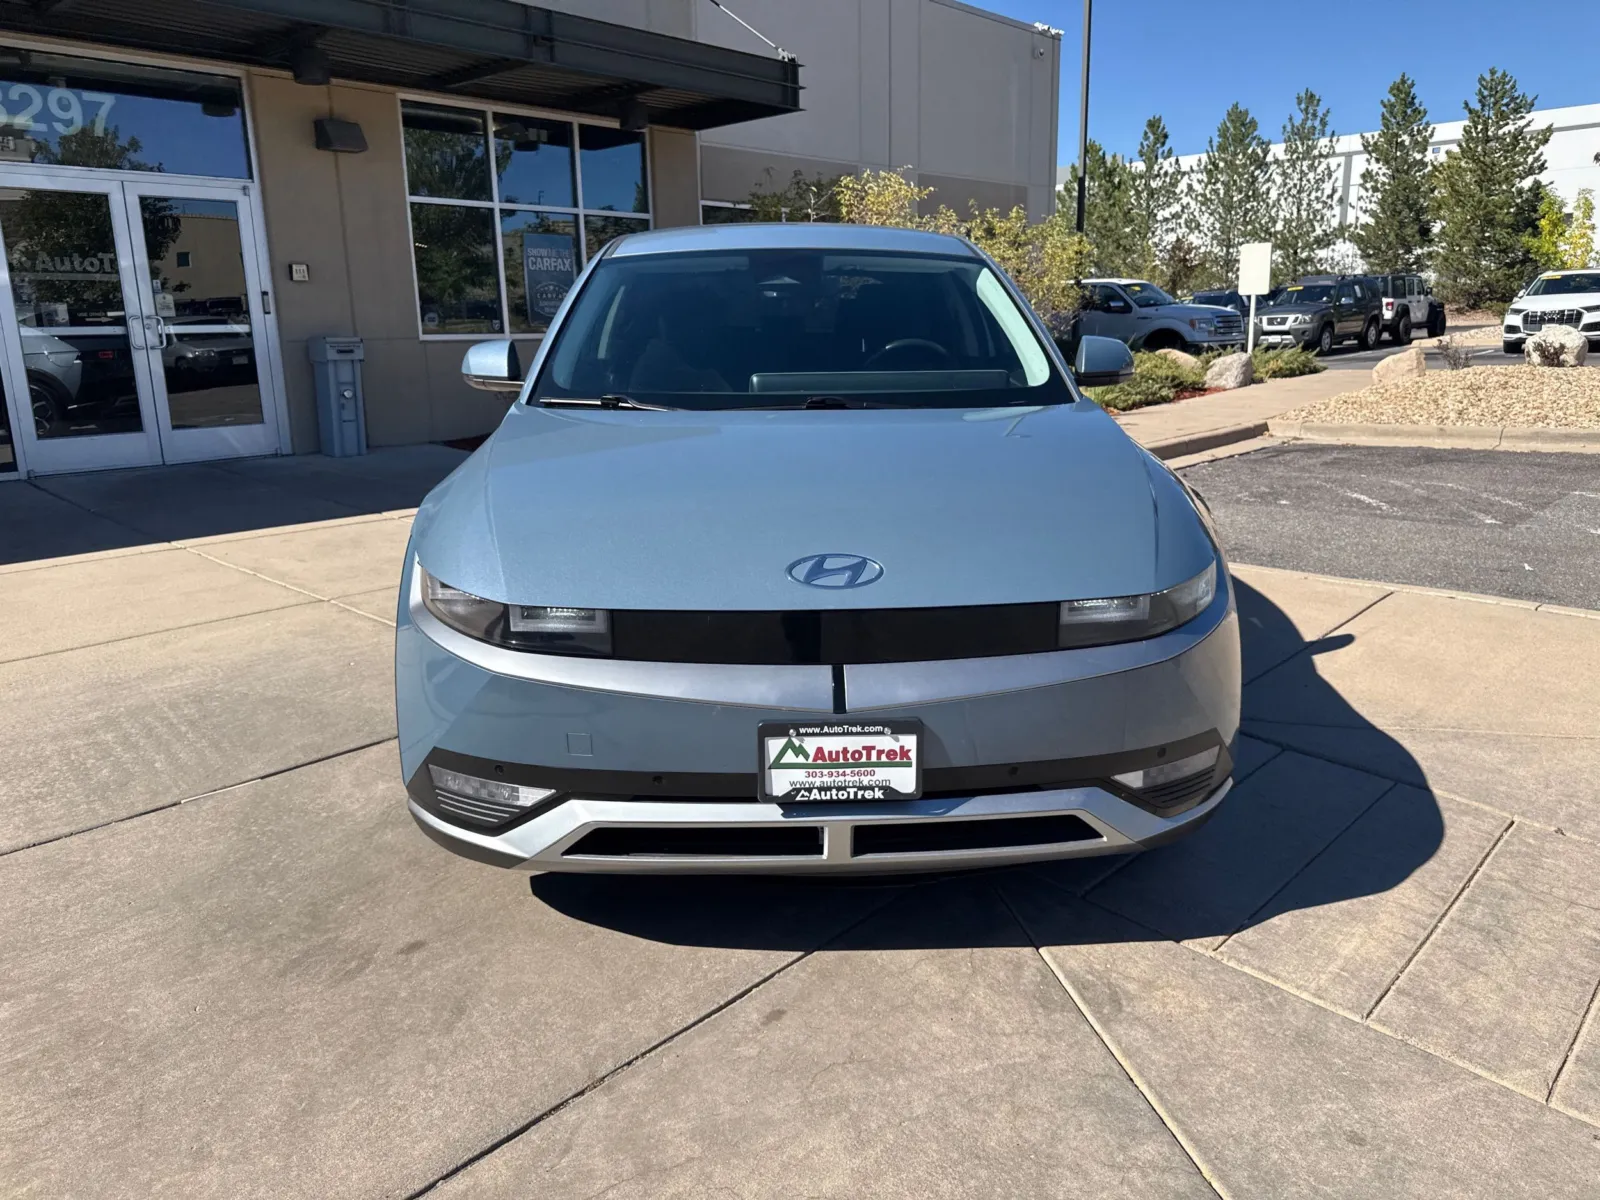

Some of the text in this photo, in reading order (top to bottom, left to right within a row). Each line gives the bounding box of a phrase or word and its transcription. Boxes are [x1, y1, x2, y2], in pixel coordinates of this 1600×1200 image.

[0, 83, 116, 137] 297
[528, 257, 572, 272] CARFAX
[799, 725, 883, 734] www.AutoTrek.com
[812, 745, 912, 763] AutoTrek
[804, 769, 876, 778] 303-934-5600
[789, 778, 891, 788] www.autotrek.com
[810, 788, 885, 801] AutoTrek
